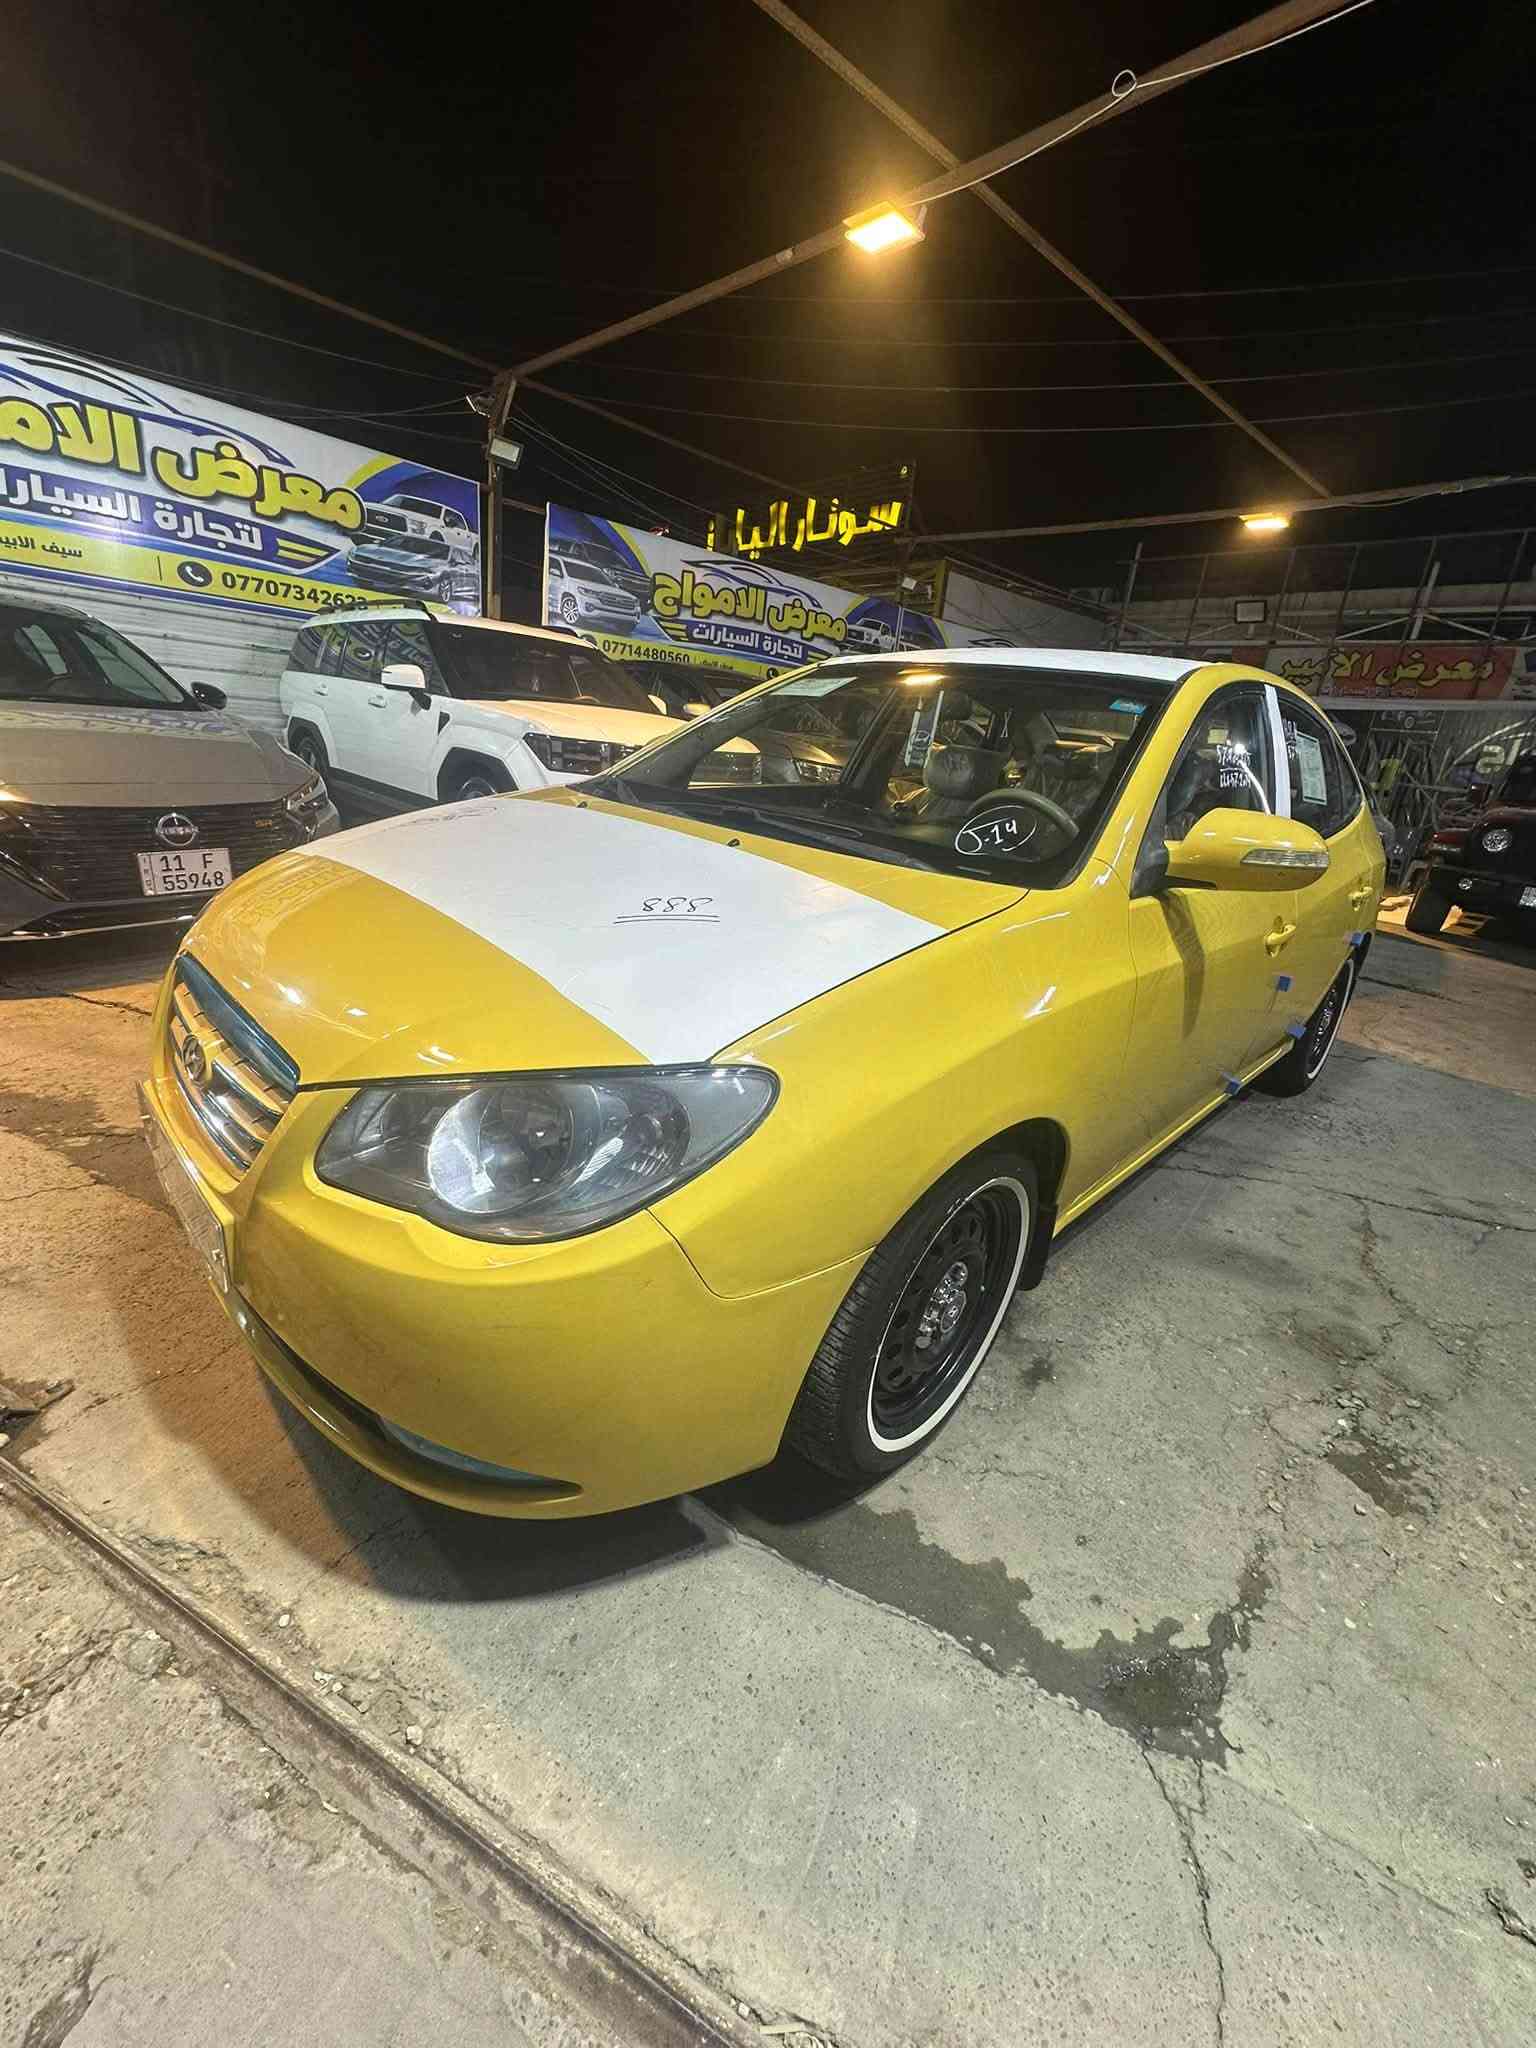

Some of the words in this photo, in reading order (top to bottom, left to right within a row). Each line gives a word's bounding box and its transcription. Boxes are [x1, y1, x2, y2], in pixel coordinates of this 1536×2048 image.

[0, 395, 145, 475] الام
[0, 468, 142, 523] السيارا
[152, 441, 366, 531] معرض
[153, 501, 264, 551] لتجارة
[791, 497, 903, 552] سونار
[0, 535, 36, 550] الابي
[40, 541, 83, 559] سيف
[653, 570, 768, 622] الامواج
[692, 623, 760, 649] السيارات
[767, 599, 848, 641] معرض
[602, 639, 690, 664] 07714480560
[763, 635, 804, 660] لتجارة
[1375, 649, 1495, 687] معرض
[160, 855, 185, 872] 11
[202, 853, 213, 869] F
[162, 871, 225, 891] 55948
[642, 896, 713, 912] 888
